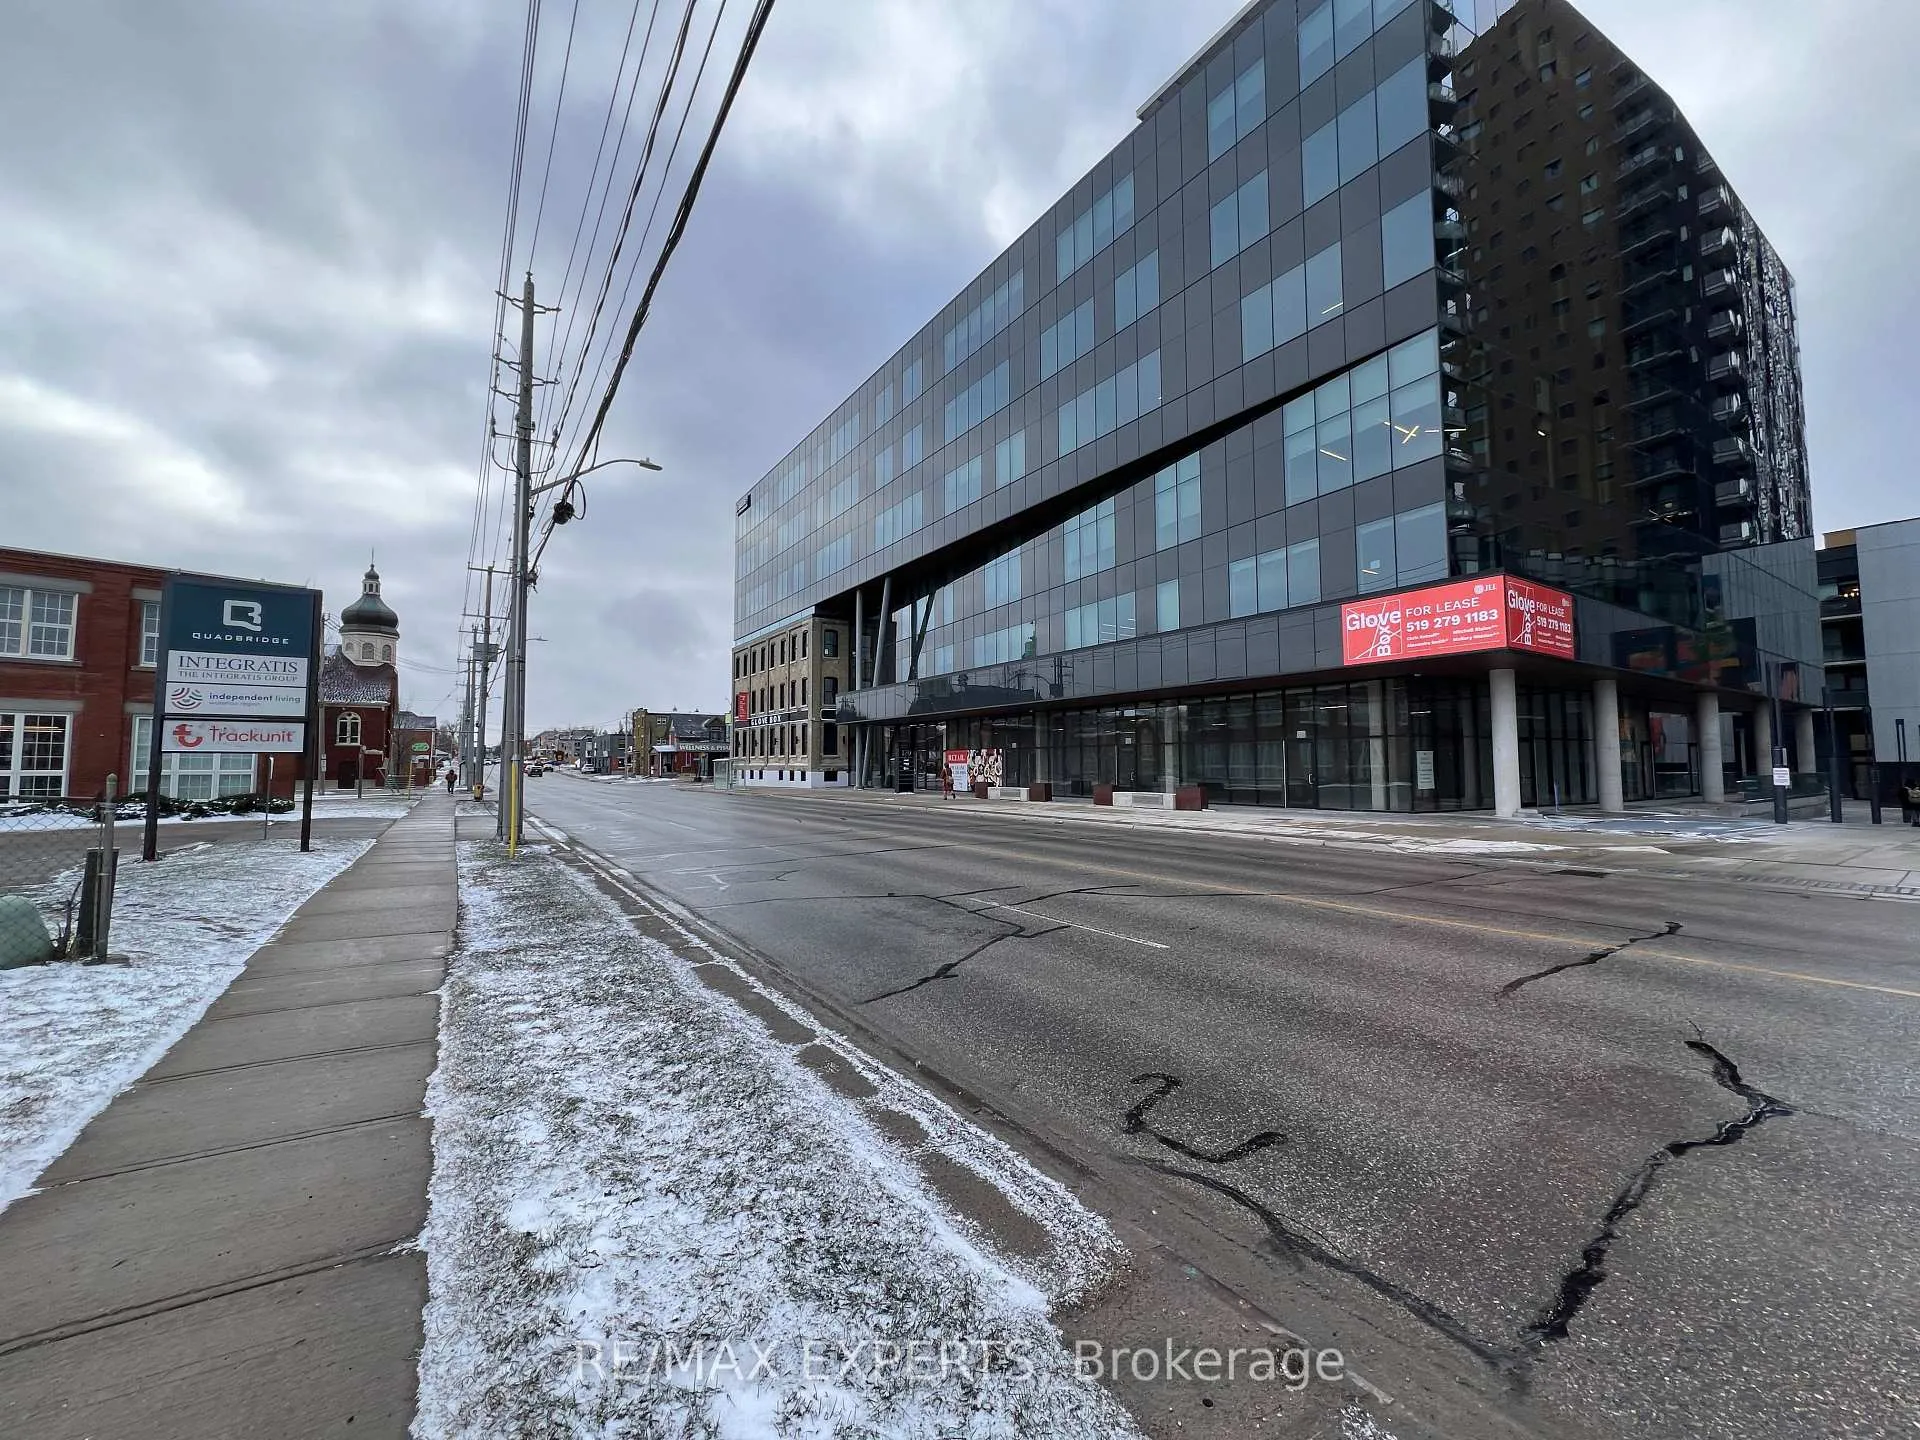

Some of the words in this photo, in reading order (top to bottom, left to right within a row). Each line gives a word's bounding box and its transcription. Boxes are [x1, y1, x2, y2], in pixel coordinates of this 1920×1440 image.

[1406, 605, 1431, 617] FOR
[1436, 597, 1480, 613] LEASE
[1508, 589, 1535, 614] Glove
[1536, 602, 1548, 613] FOR
[1549, 605, 1565, 618] LEASE
[1346, 610, 1401, 631] Glove
[1406, 620, 1429, 632] 519
[1434, 615, 1461, 628] 279
[1465, 609, 1498, 624] 1183
[1537, 616, 1547, 628] 519
[1548, 619, 1559, 630] 279
[1560, 621, 1571, 634] 1183
[192, 632, 289, 645] QUADBRIDGE
[179, 655, 298, 673] INTEGRATIS
[202, 672, 262, 681] INTEGRATIS
[209, 692, 273, 702] independent
[275, 695, 301, 703] living
[751, 717, 768, 726] GLOVE
[209, 726, 293, 742] Trackunit
